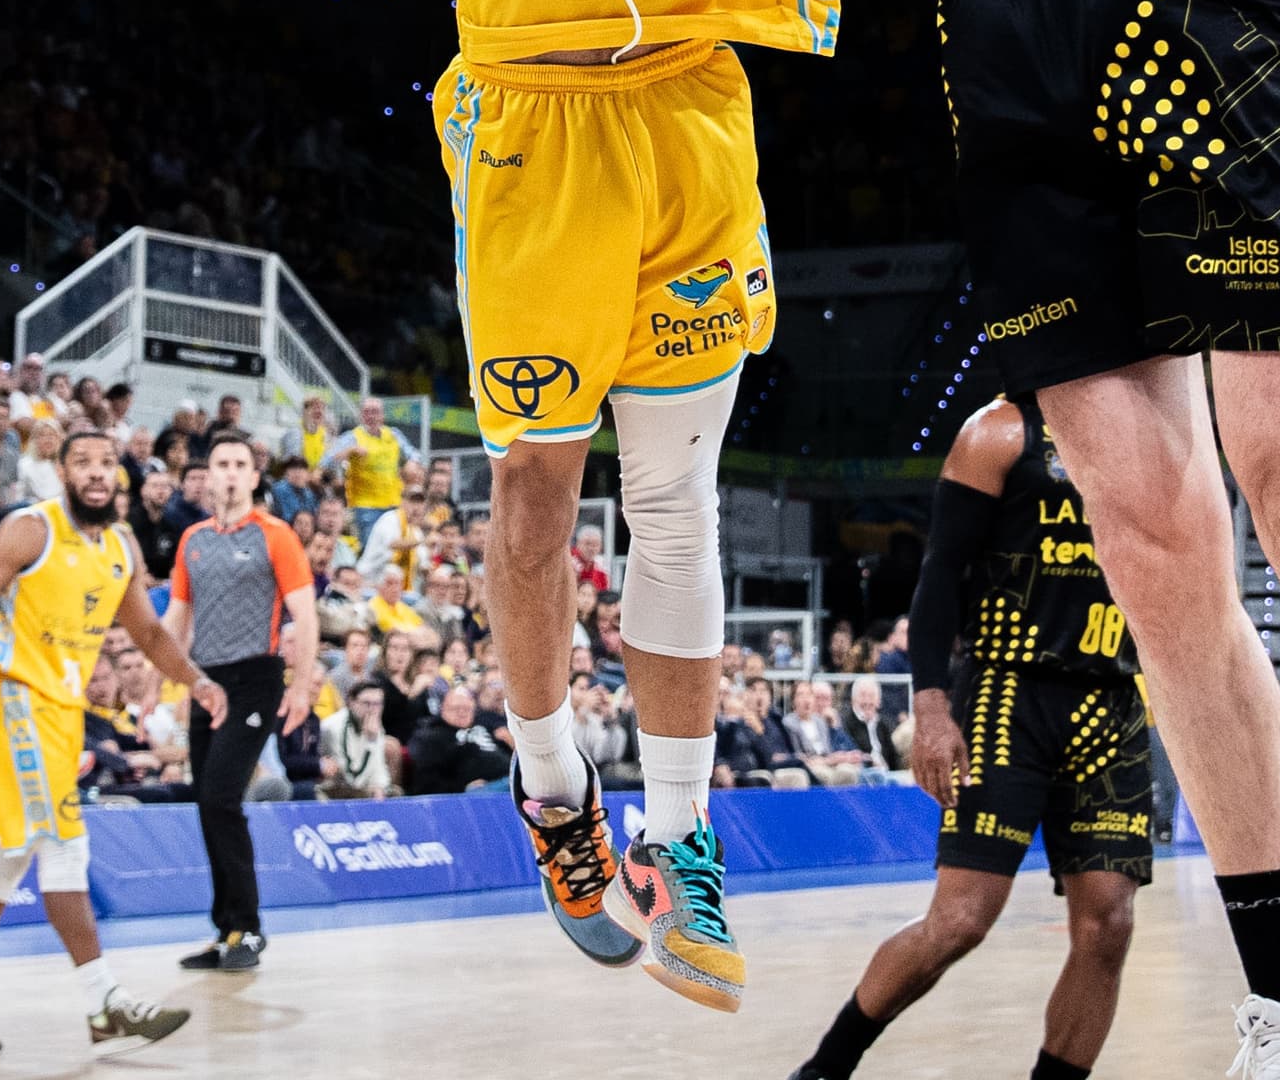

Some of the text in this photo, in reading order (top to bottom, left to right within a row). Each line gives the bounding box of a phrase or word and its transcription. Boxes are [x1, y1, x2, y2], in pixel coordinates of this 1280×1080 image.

[1229, 236, 1279, 256] Islas
[1185, 254, 1279, 275] Canarias
[748, 280, 764, 295] acb
[650, 307, 743, 336] Poema
[655, 335, 695, 357] del
[1039, 499, 1077, 524] LA
[1079, 602, 1126, 658] 88
